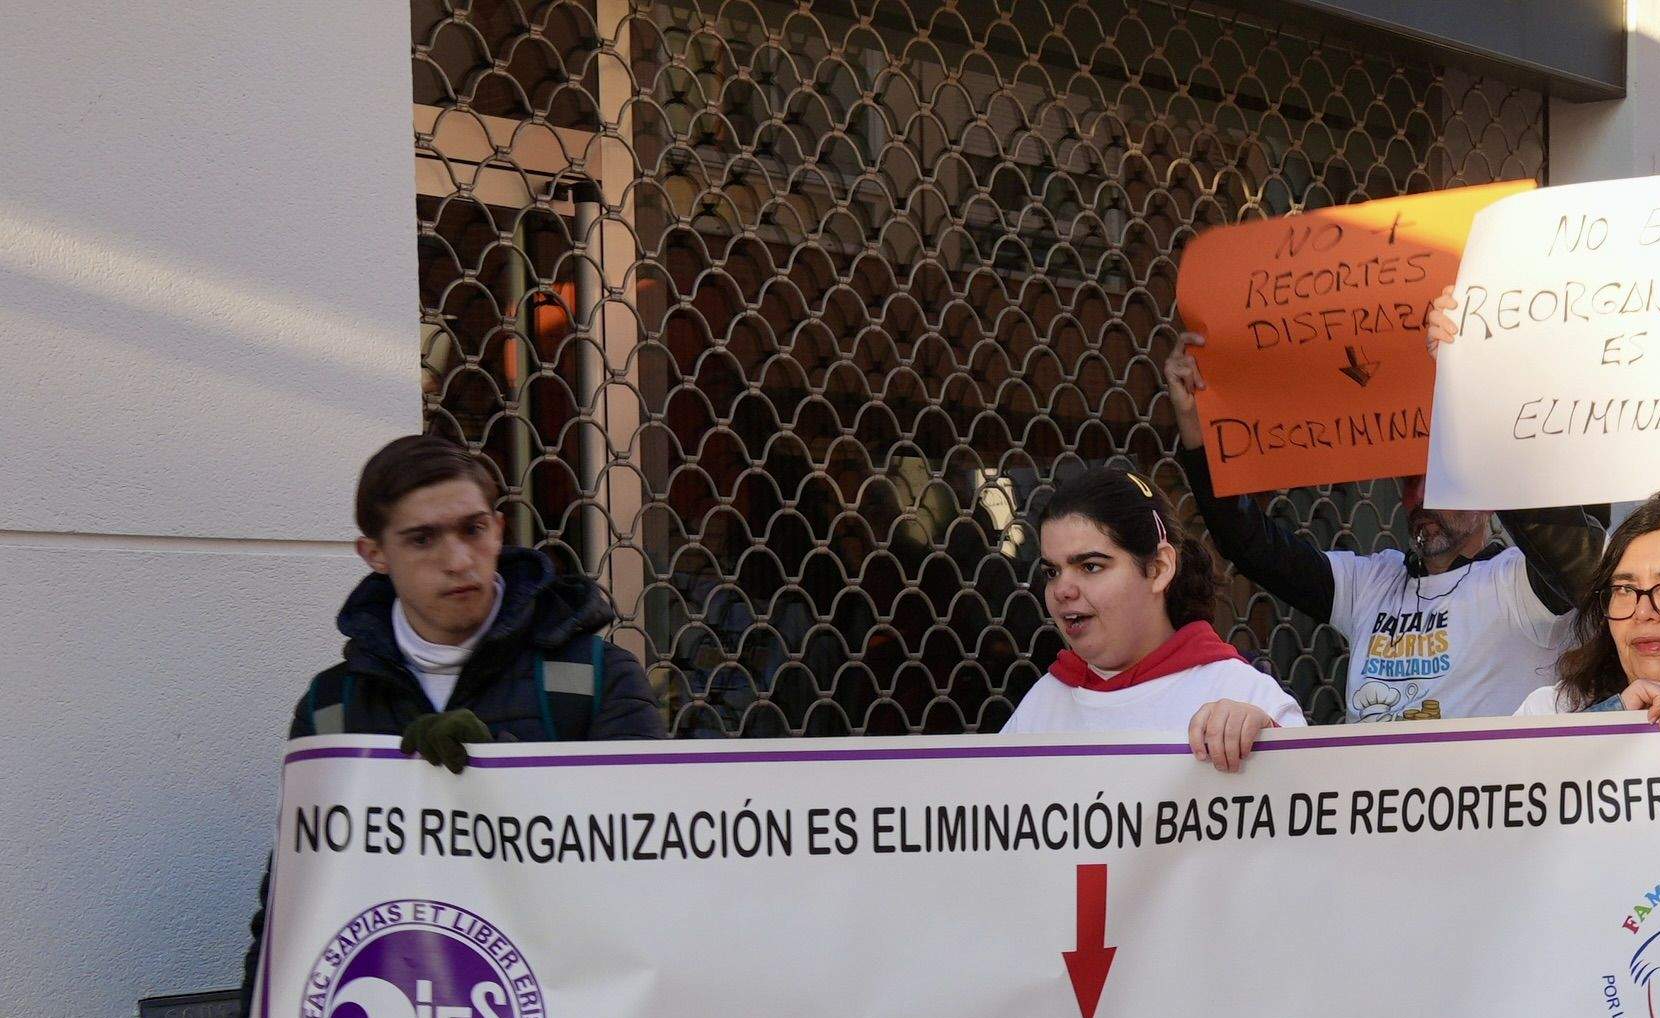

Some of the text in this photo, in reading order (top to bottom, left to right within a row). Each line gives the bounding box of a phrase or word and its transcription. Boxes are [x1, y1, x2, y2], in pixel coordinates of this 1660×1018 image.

[1275, 223, 1344, 260] NO
[1548, 214, 1609, 257] NO
[1245, 252, 1432, 309] RECORTES
[1248, 300, 1438, 351] DISFRAZA
[1601, 331, 1648, 365] ES
[1210, 405, 1431, 464] DISCRIMINA
[295, 804, 352, 854] NO
[365, 806, 406, 854] ES
[420, 798, 793, 864] REORGANIZACIÓN
[808, 806, 858, 855] ES
[872, 791, 1142, 853] ELIMINACIÓN
[1154, 793, 1276, 845] BASTA
[1288, 791, 1339, 837] DE
[1350, 781, 1547, 835] RECORTES
[325, 904, 402, 966] SAPIAS
[413, 903, 446, 924] ET
[453, 912, 519, 970] LIBER
[1602, 974, 1621, 1011] POR
